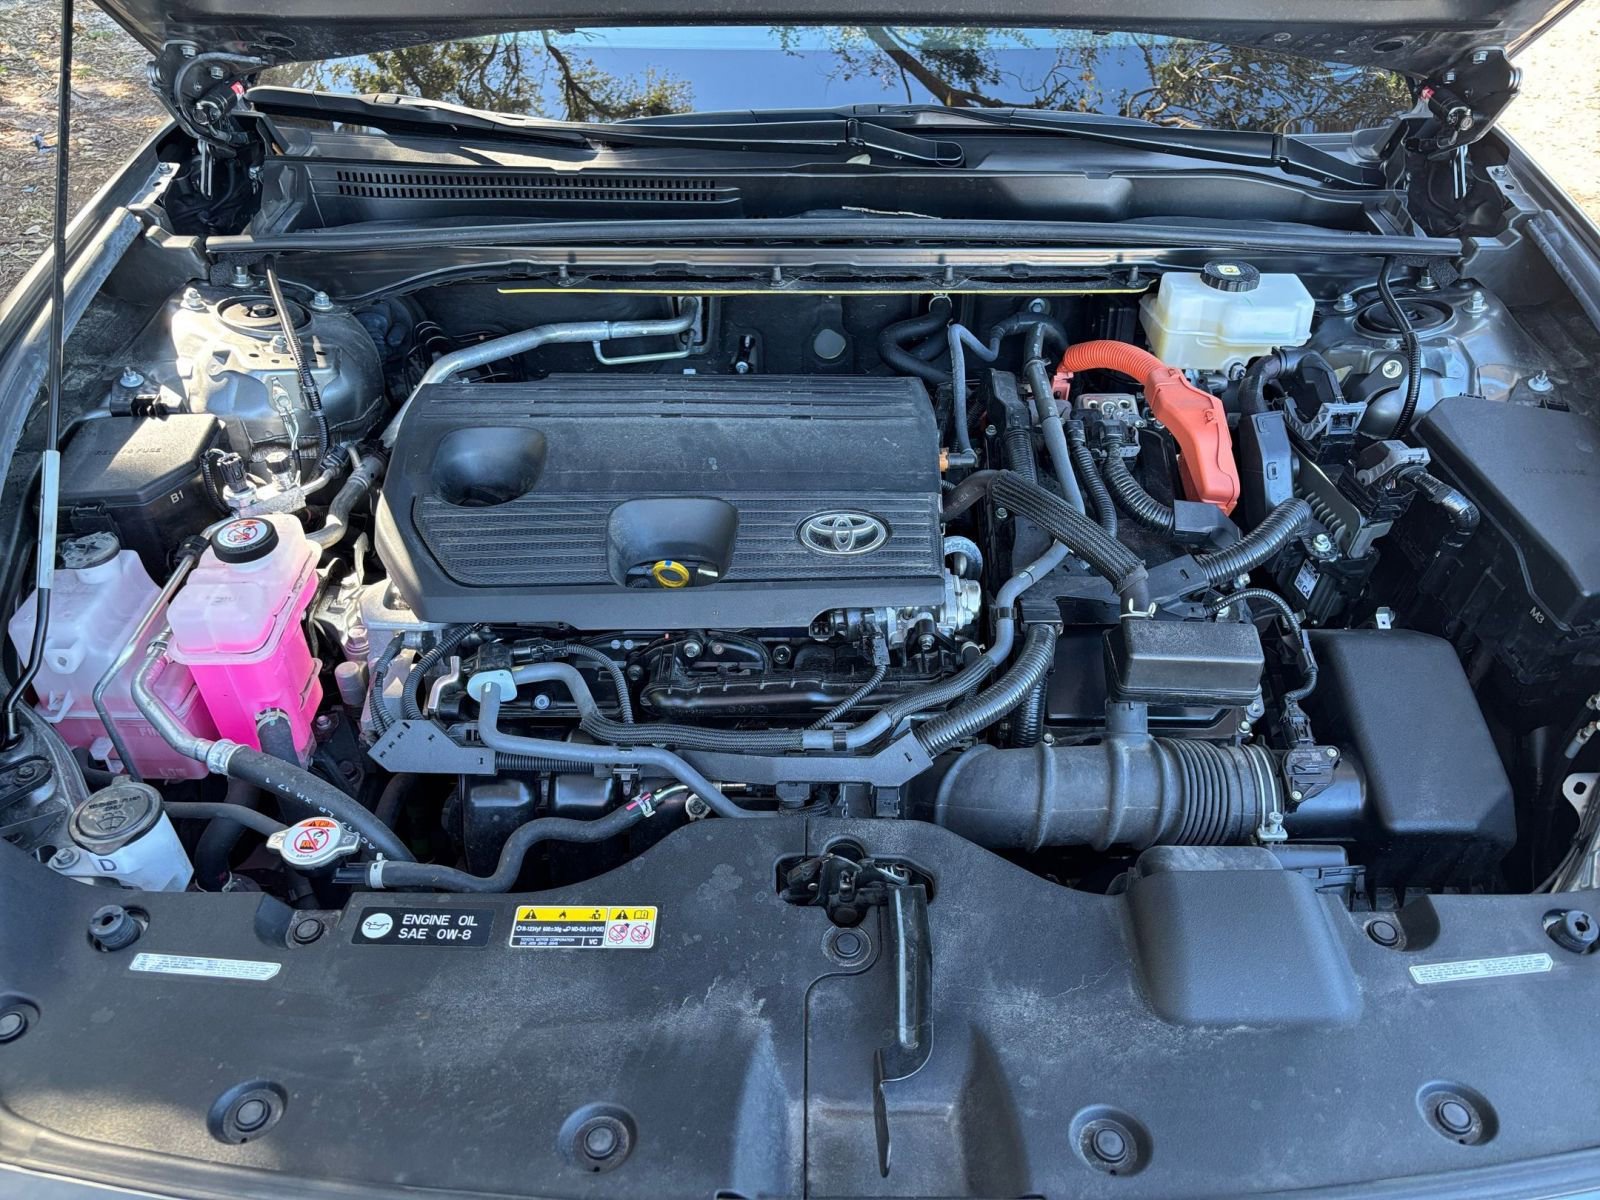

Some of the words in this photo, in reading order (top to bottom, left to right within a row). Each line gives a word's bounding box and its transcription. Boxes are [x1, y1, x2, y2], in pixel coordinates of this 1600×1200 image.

[170, 489, 184, 504] B1
[1529, 606, 1545, 624] M3
[98, 859, 117, 872] D
[402, 914, 451, 926] ENGINE
[458, 915, 478, 927] OIL
[398, 928, 428, 939] SAE
